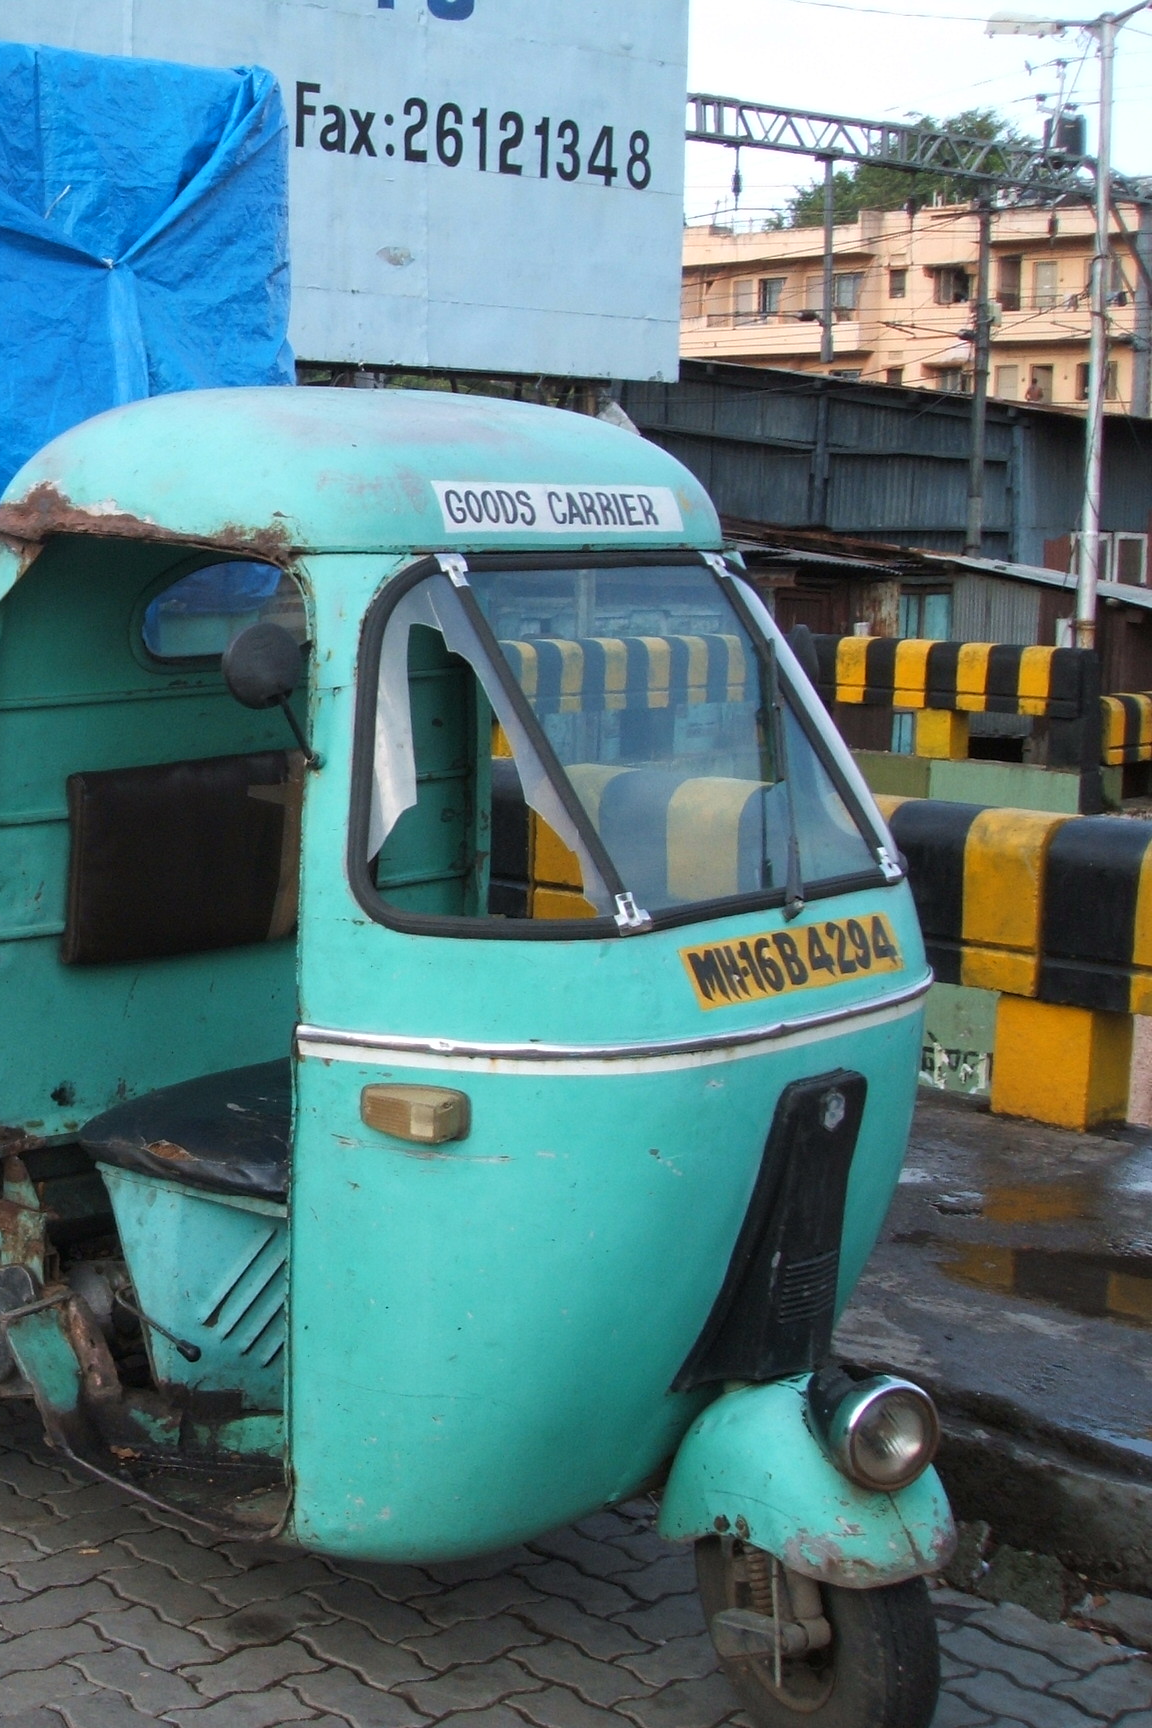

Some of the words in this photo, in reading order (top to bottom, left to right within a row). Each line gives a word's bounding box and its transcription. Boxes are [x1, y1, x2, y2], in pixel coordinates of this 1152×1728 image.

[295, 80, 652, 191] Fax:26121348
[444, 489, 536, 526] GOODS
[547, 491, 660, 526] CARRIER
